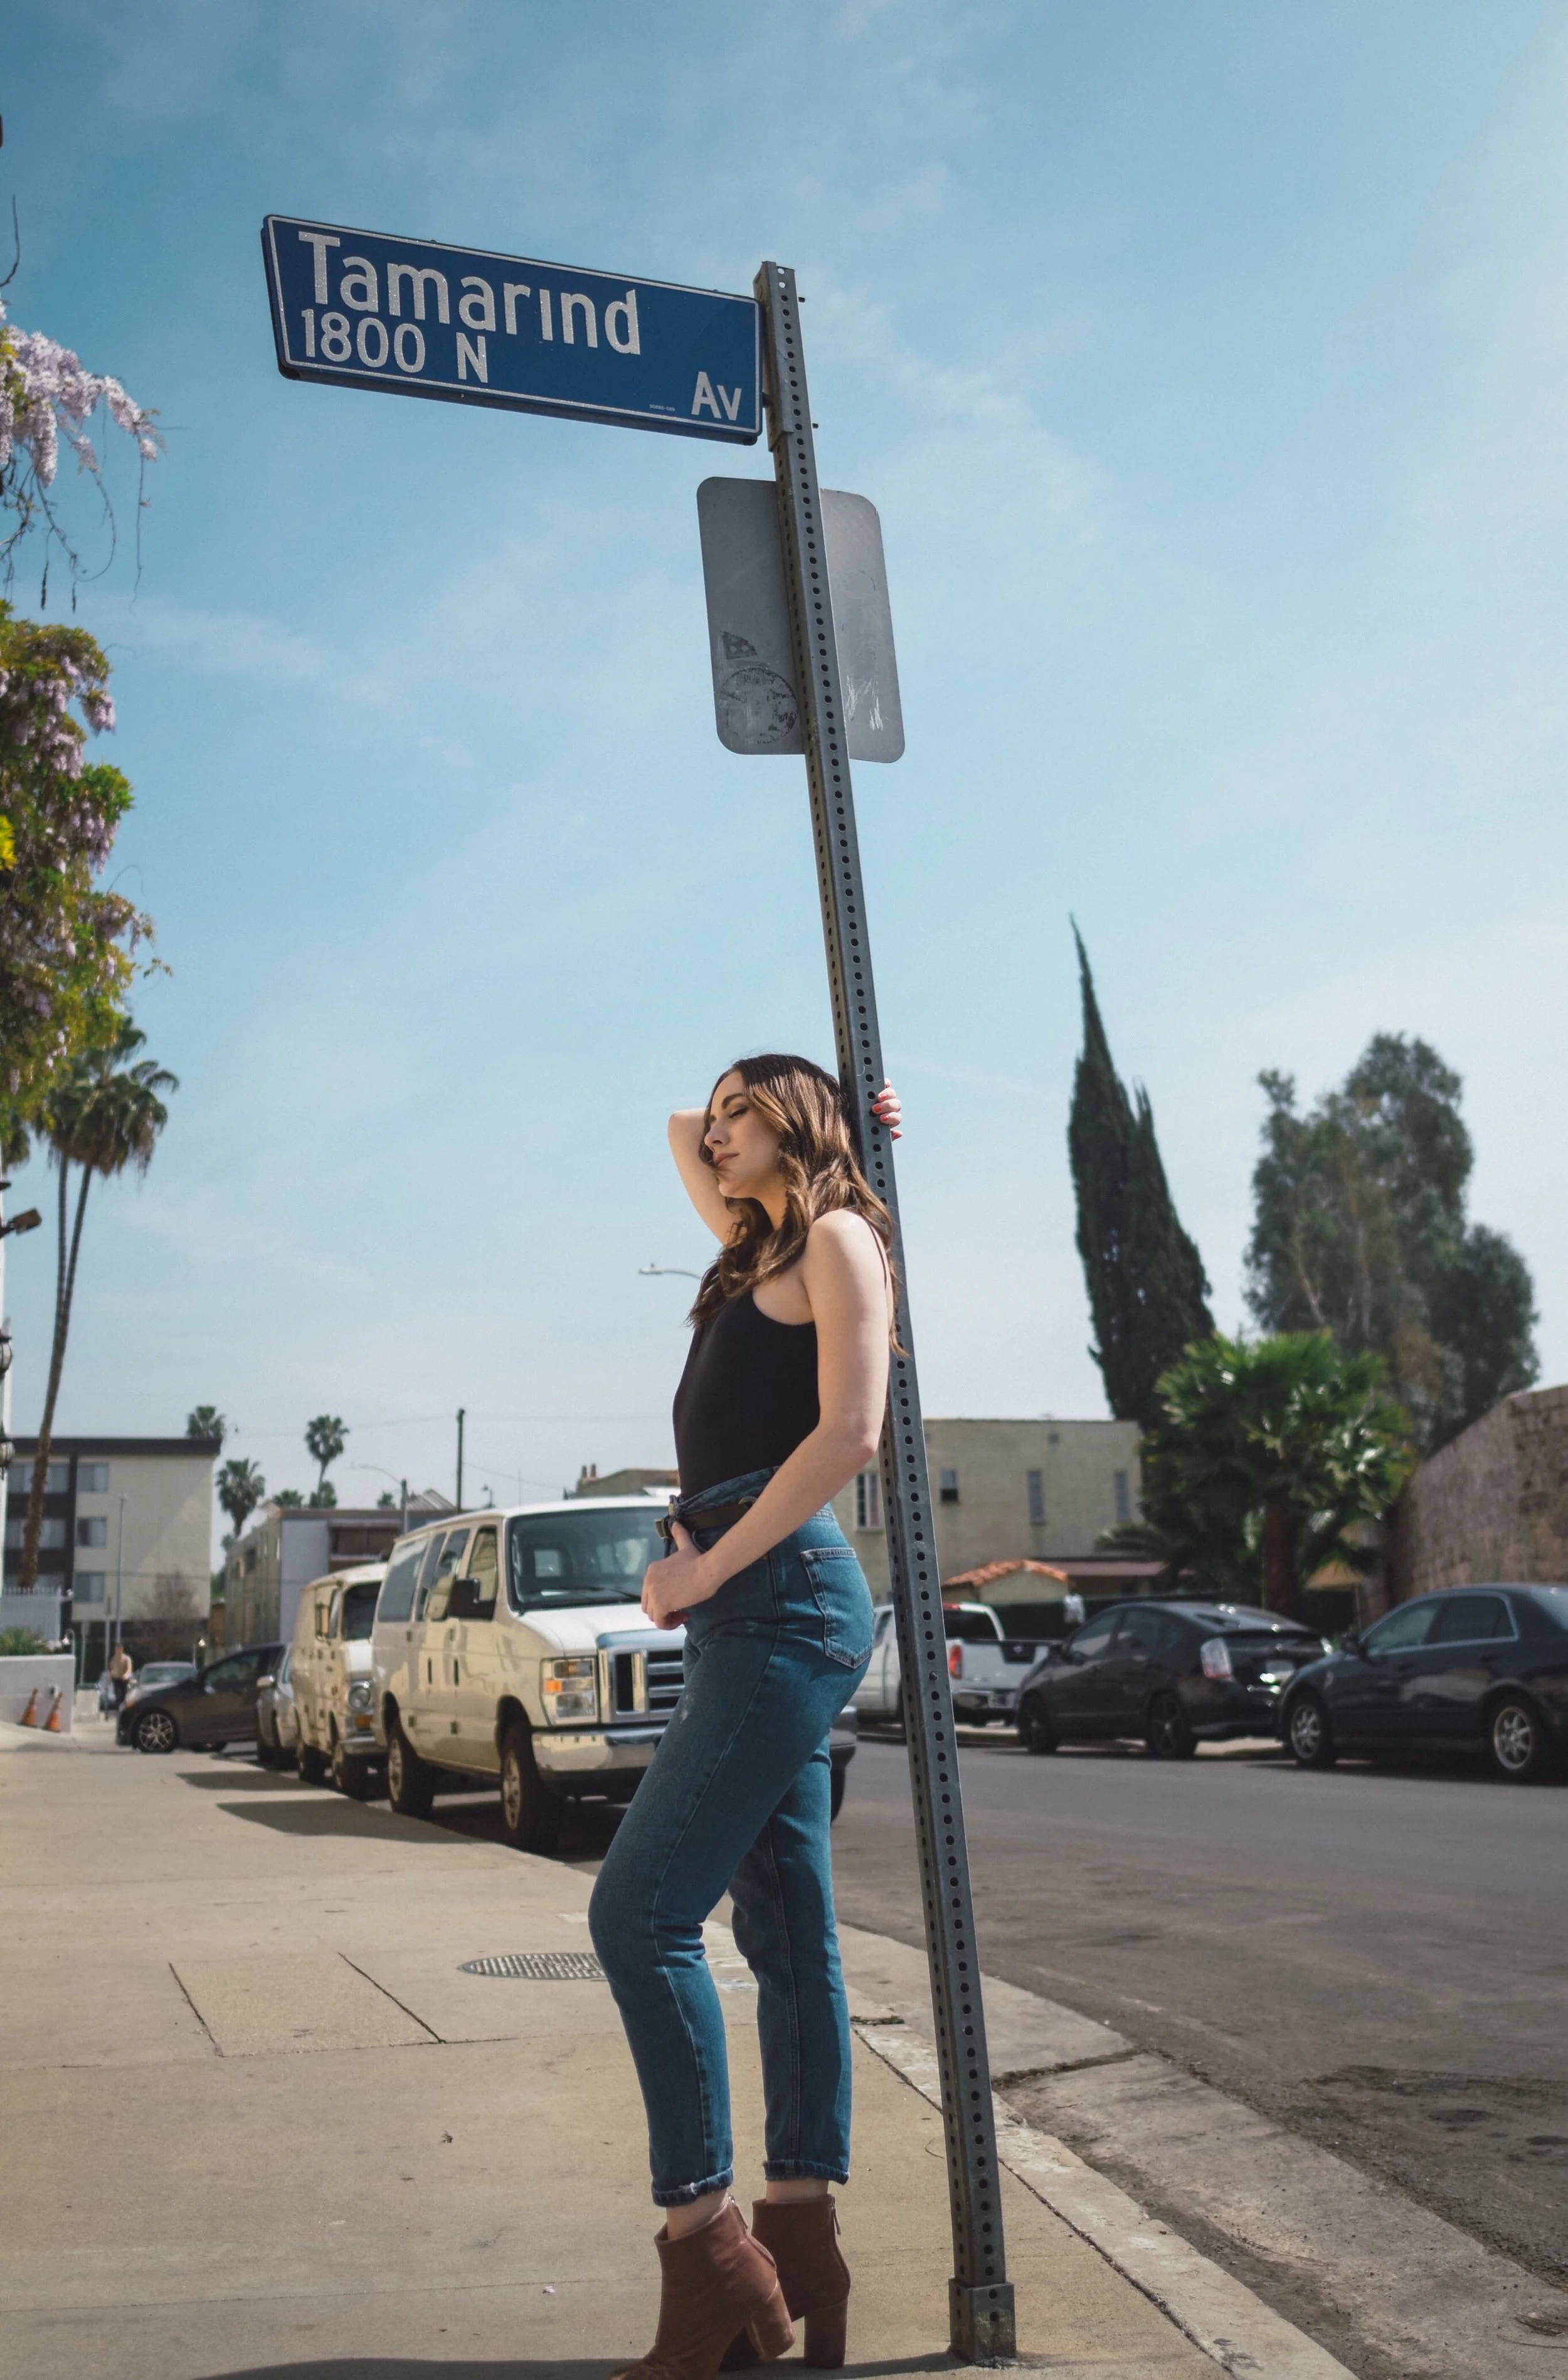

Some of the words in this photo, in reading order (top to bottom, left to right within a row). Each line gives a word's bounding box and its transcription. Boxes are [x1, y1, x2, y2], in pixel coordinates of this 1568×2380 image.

[299, 231, 640, 355] Tamarind
[302, 309, 425, 373] 1800
[456, 332, 488, 383] N
[691, 371, 741, 421] Av
